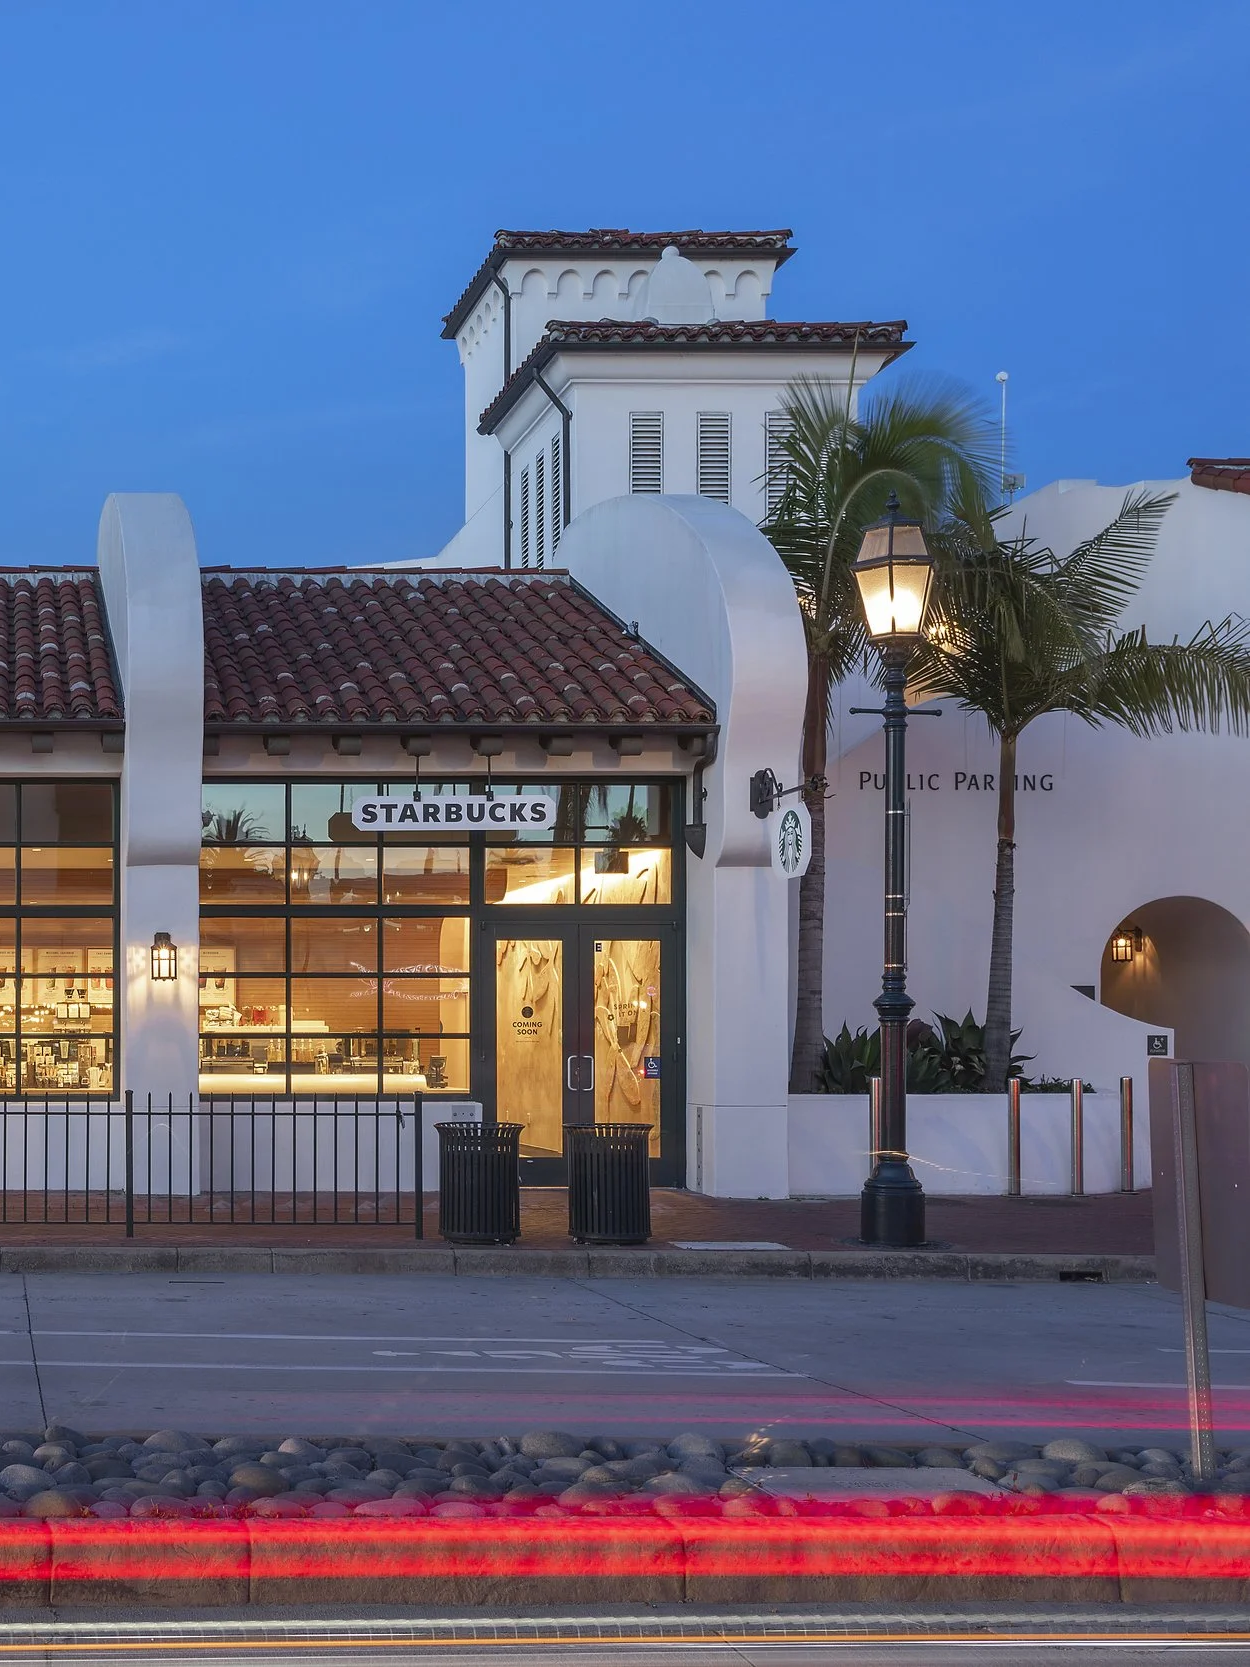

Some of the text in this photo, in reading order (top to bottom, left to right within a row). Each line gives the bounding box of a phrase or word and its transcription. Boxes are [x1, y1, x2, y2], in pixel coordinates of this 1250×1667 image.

[859, 771, 1054, 791] PULIC PARING
[361, 803, 547, 823] STARBUCKS
[614, 1002, 639, 1010] SPRIN
